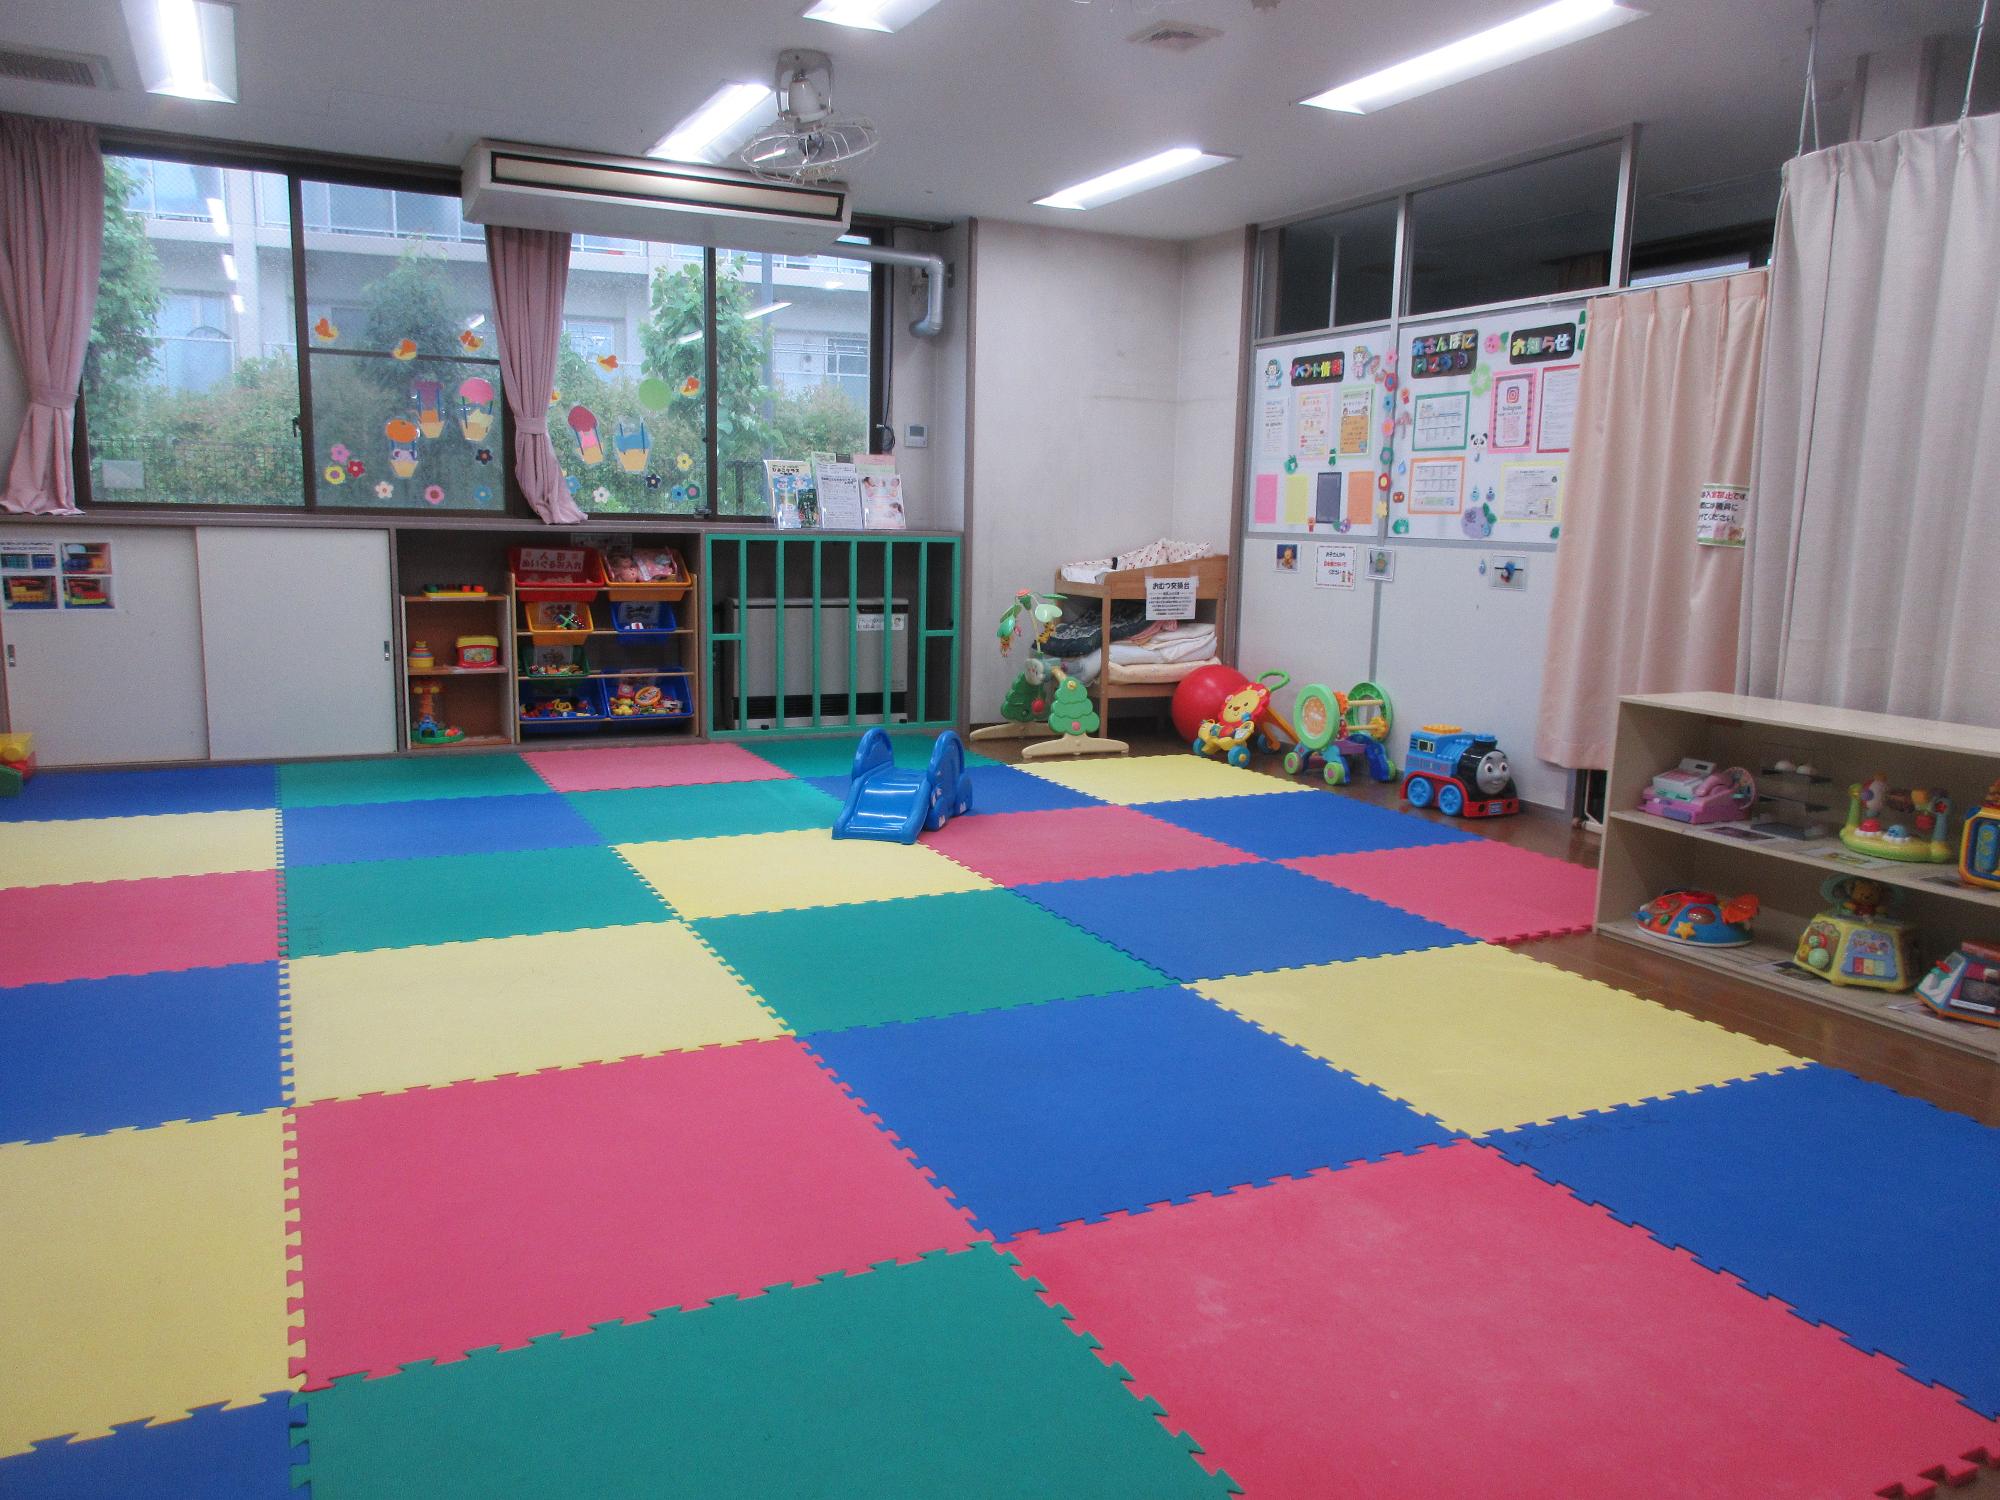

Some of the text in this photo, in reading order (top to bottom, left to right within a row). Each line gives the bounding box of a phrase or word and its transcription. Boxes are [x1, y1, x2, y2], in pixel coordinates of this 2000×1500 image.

[1153, 582, 1190, 590] おむつ交換台
